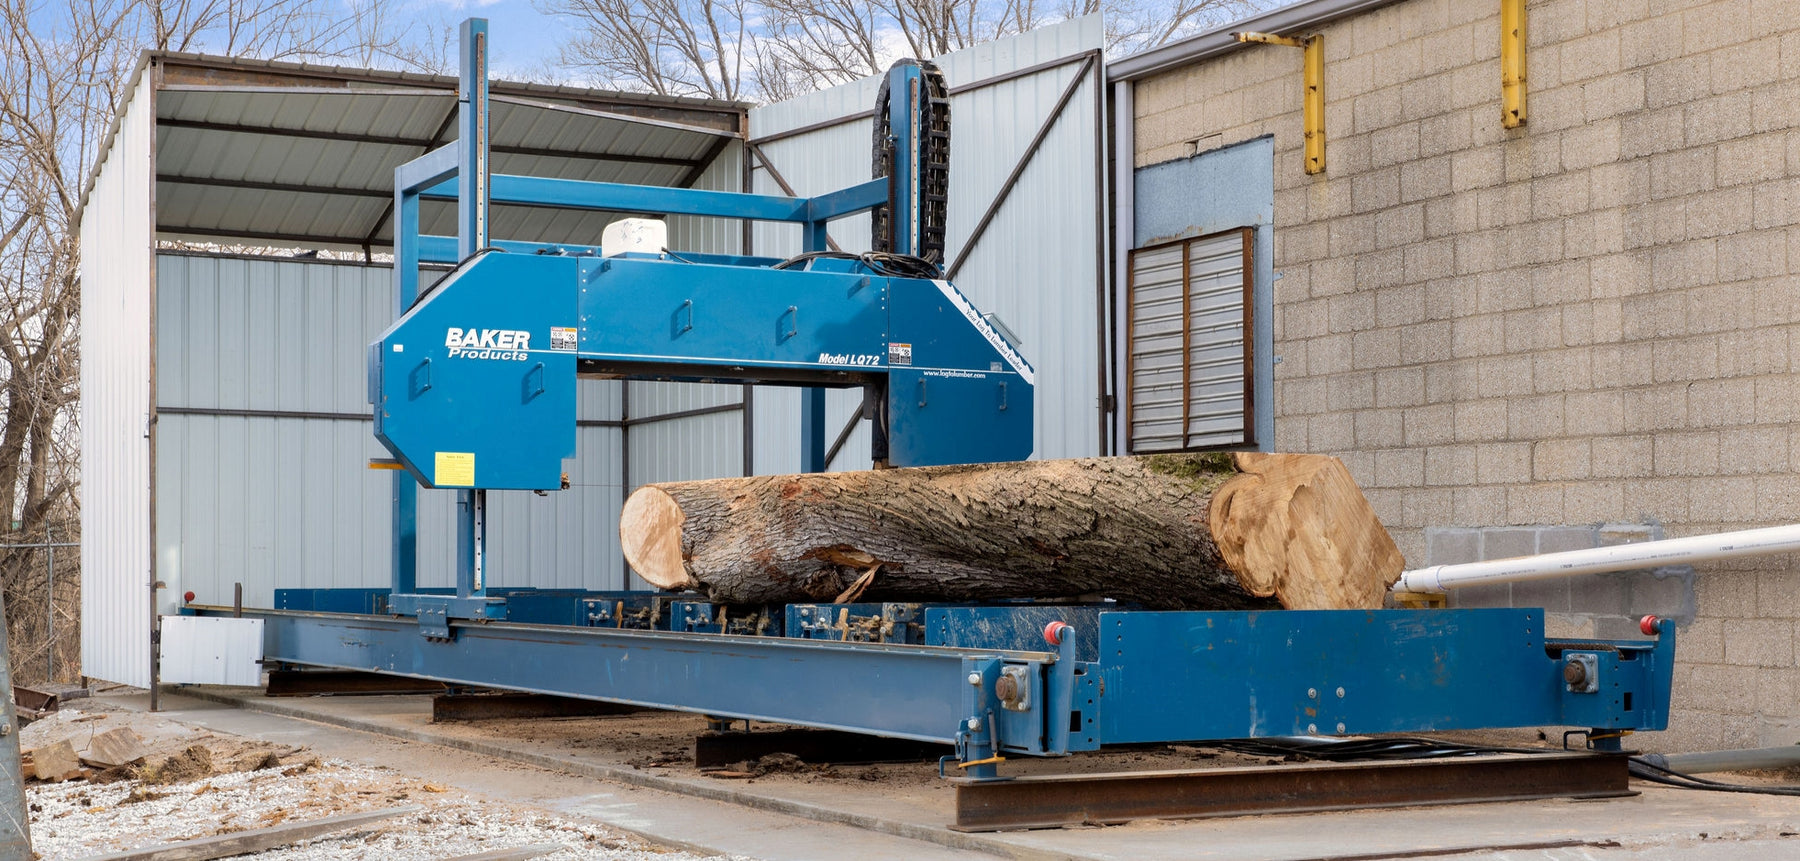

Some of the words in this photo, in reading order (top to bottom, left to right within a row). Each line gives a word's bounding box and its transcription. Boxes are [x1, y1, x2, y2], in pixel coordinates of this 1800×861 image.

[445, 327, 531, 350] BAKER
[448, 347, 529, 361] Products
[818, 352, 849, 364] Model
[850, 355, 880, 366] LQ72
[923, 370, 986, 379] www.logtolumber.com
